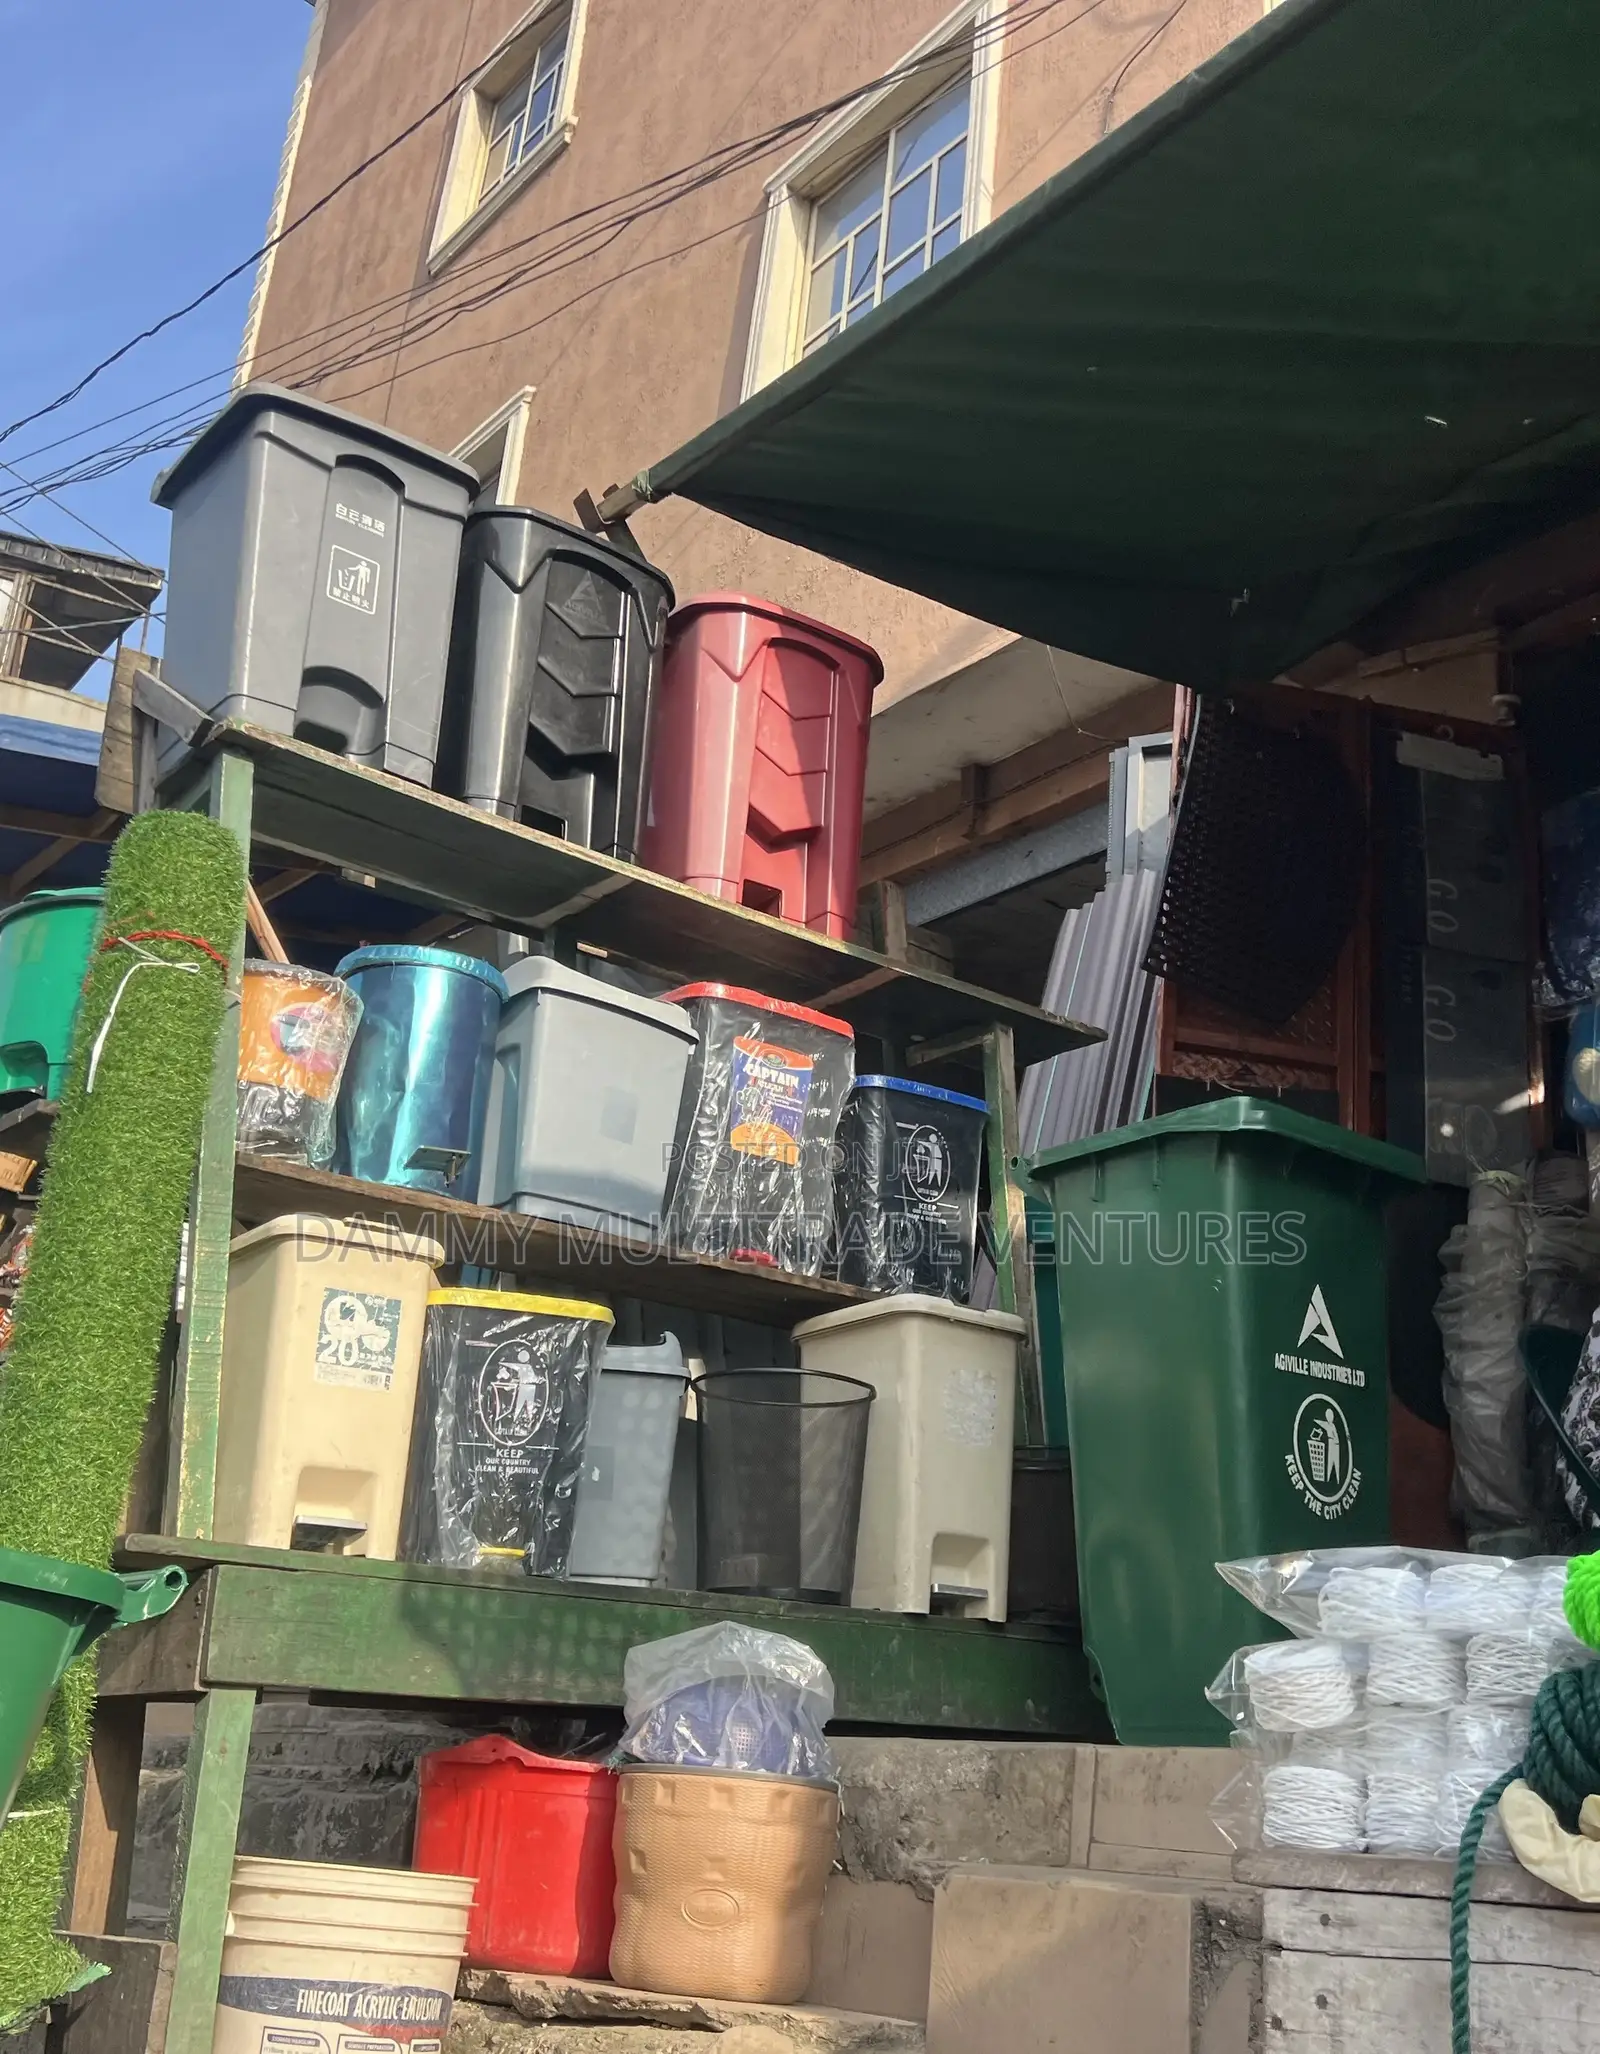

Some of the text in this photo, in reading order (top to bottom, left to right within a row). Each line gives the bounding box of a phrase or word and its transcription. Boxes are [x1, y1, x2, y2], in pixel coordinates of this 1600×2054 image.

[743, 1063, 799, 1089] CAPTAIN
[918, 1202, 937, 1212] KEEP
[317, 1333, 360, 1367] 20
[1274, 1352, 1309, 1376] AGIVILLE
[1352, 1369, 1365, 1388] LTD
[485, 1456, 531, 1466] OUR COUNTRY
[496, 1448, 524, 1459] KEEP
[505, 1466, 539, 1475] BEAUTIFUL
[1284, 1454, 1362, 1521] KEEP THE CITY CLEAN
[296, 1988, 351, 2018] FINECOAT
